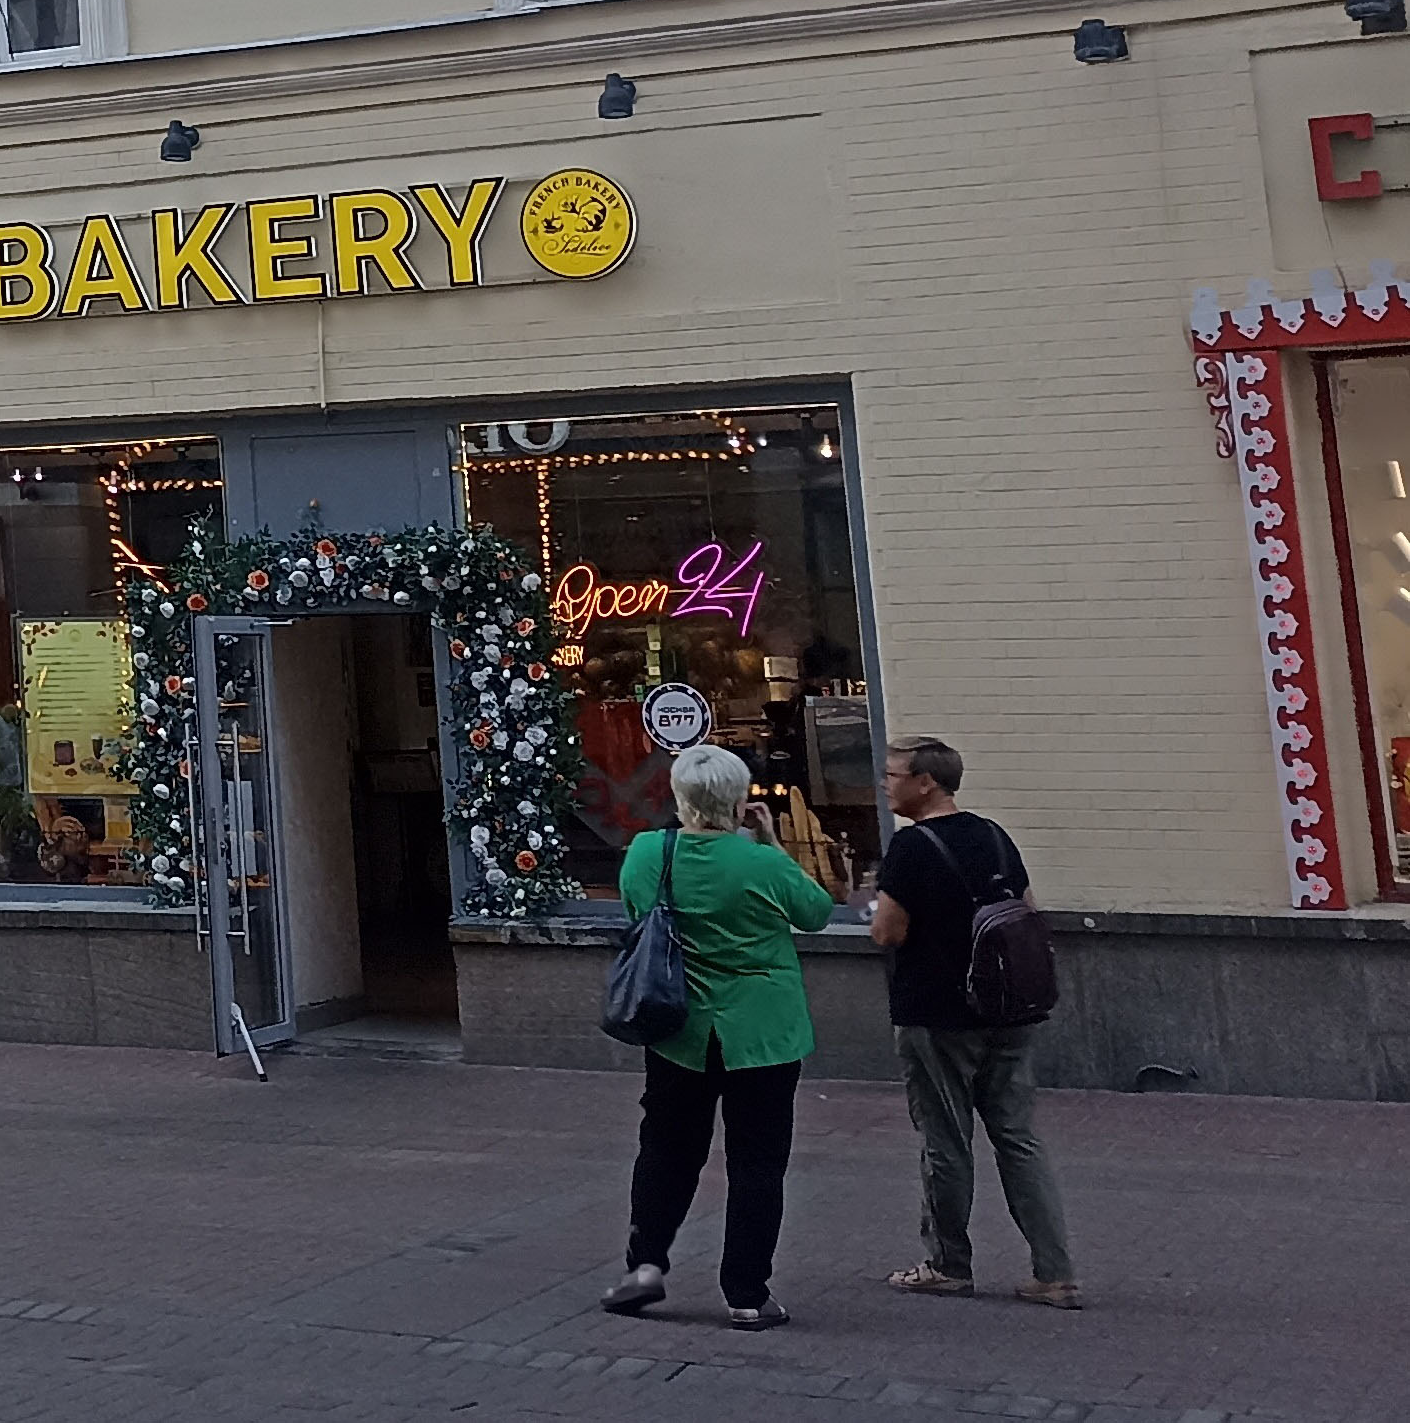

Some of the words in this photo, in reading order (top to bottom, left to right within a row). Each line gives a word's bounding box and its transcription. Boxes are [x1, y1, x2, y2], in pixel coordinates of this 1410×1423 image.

[529, 177, 569, 216] FRENCH
[576, 177, 621, 210] BAKERY
[670, 541, 764, 637] 24
[658, 714, 696, 727] 877
